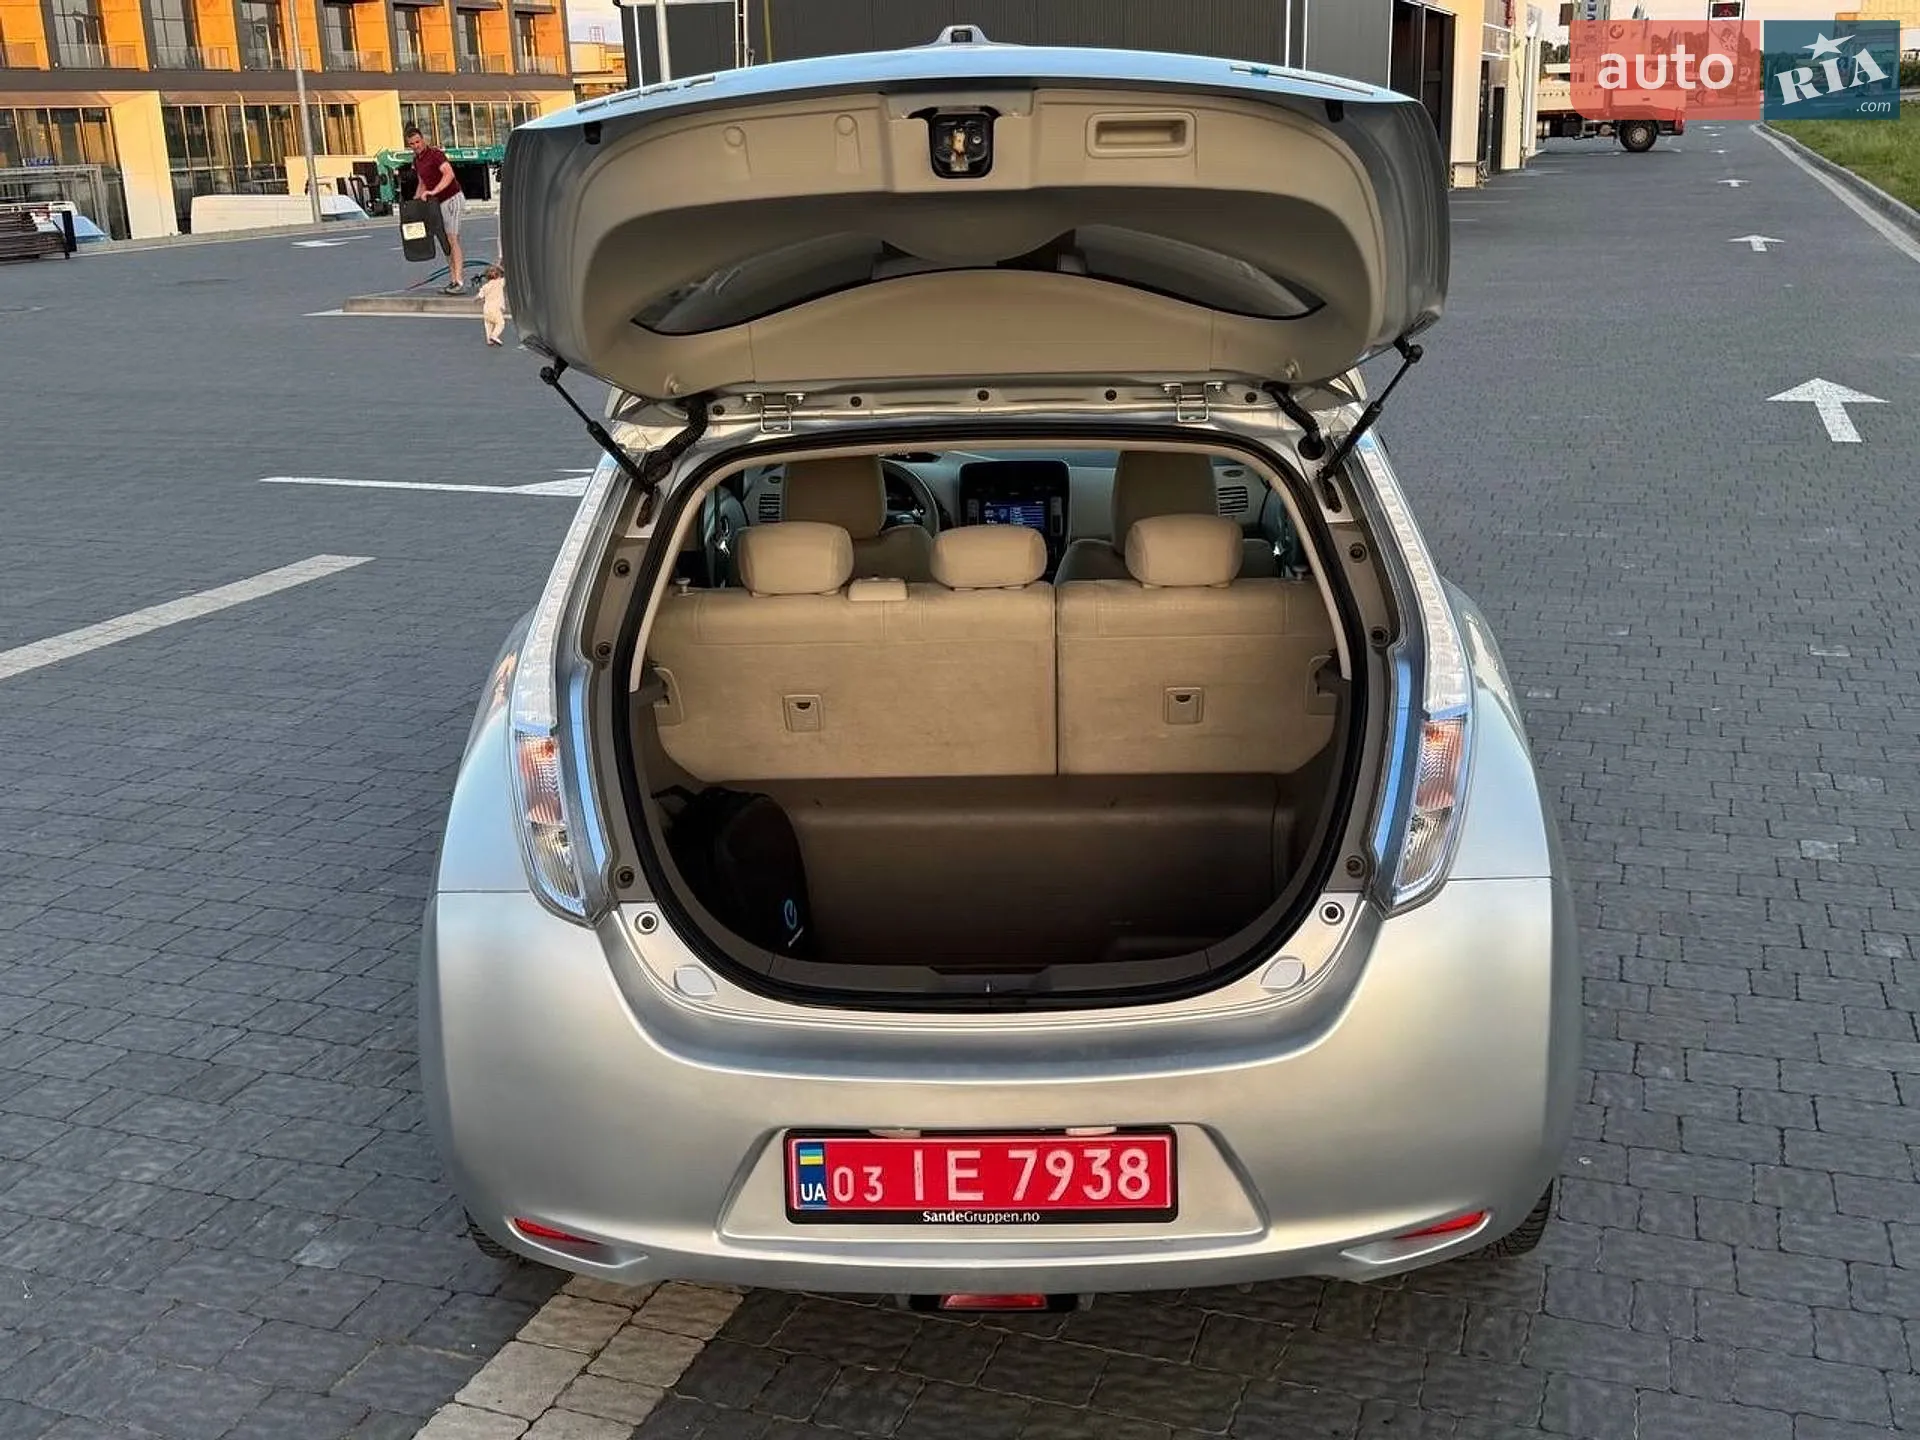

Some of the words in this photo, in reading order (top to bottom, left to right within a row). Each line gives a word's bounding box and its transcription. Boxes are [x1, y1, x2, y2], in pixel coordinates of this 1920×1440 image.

[800, 1183, 827, 1201] UA
[833, 1166, 884, 1202] 03
[1007, 1148, 1151, 1201] 7938
[922, 1210, 1041, 1224] SandeGruppen.no
